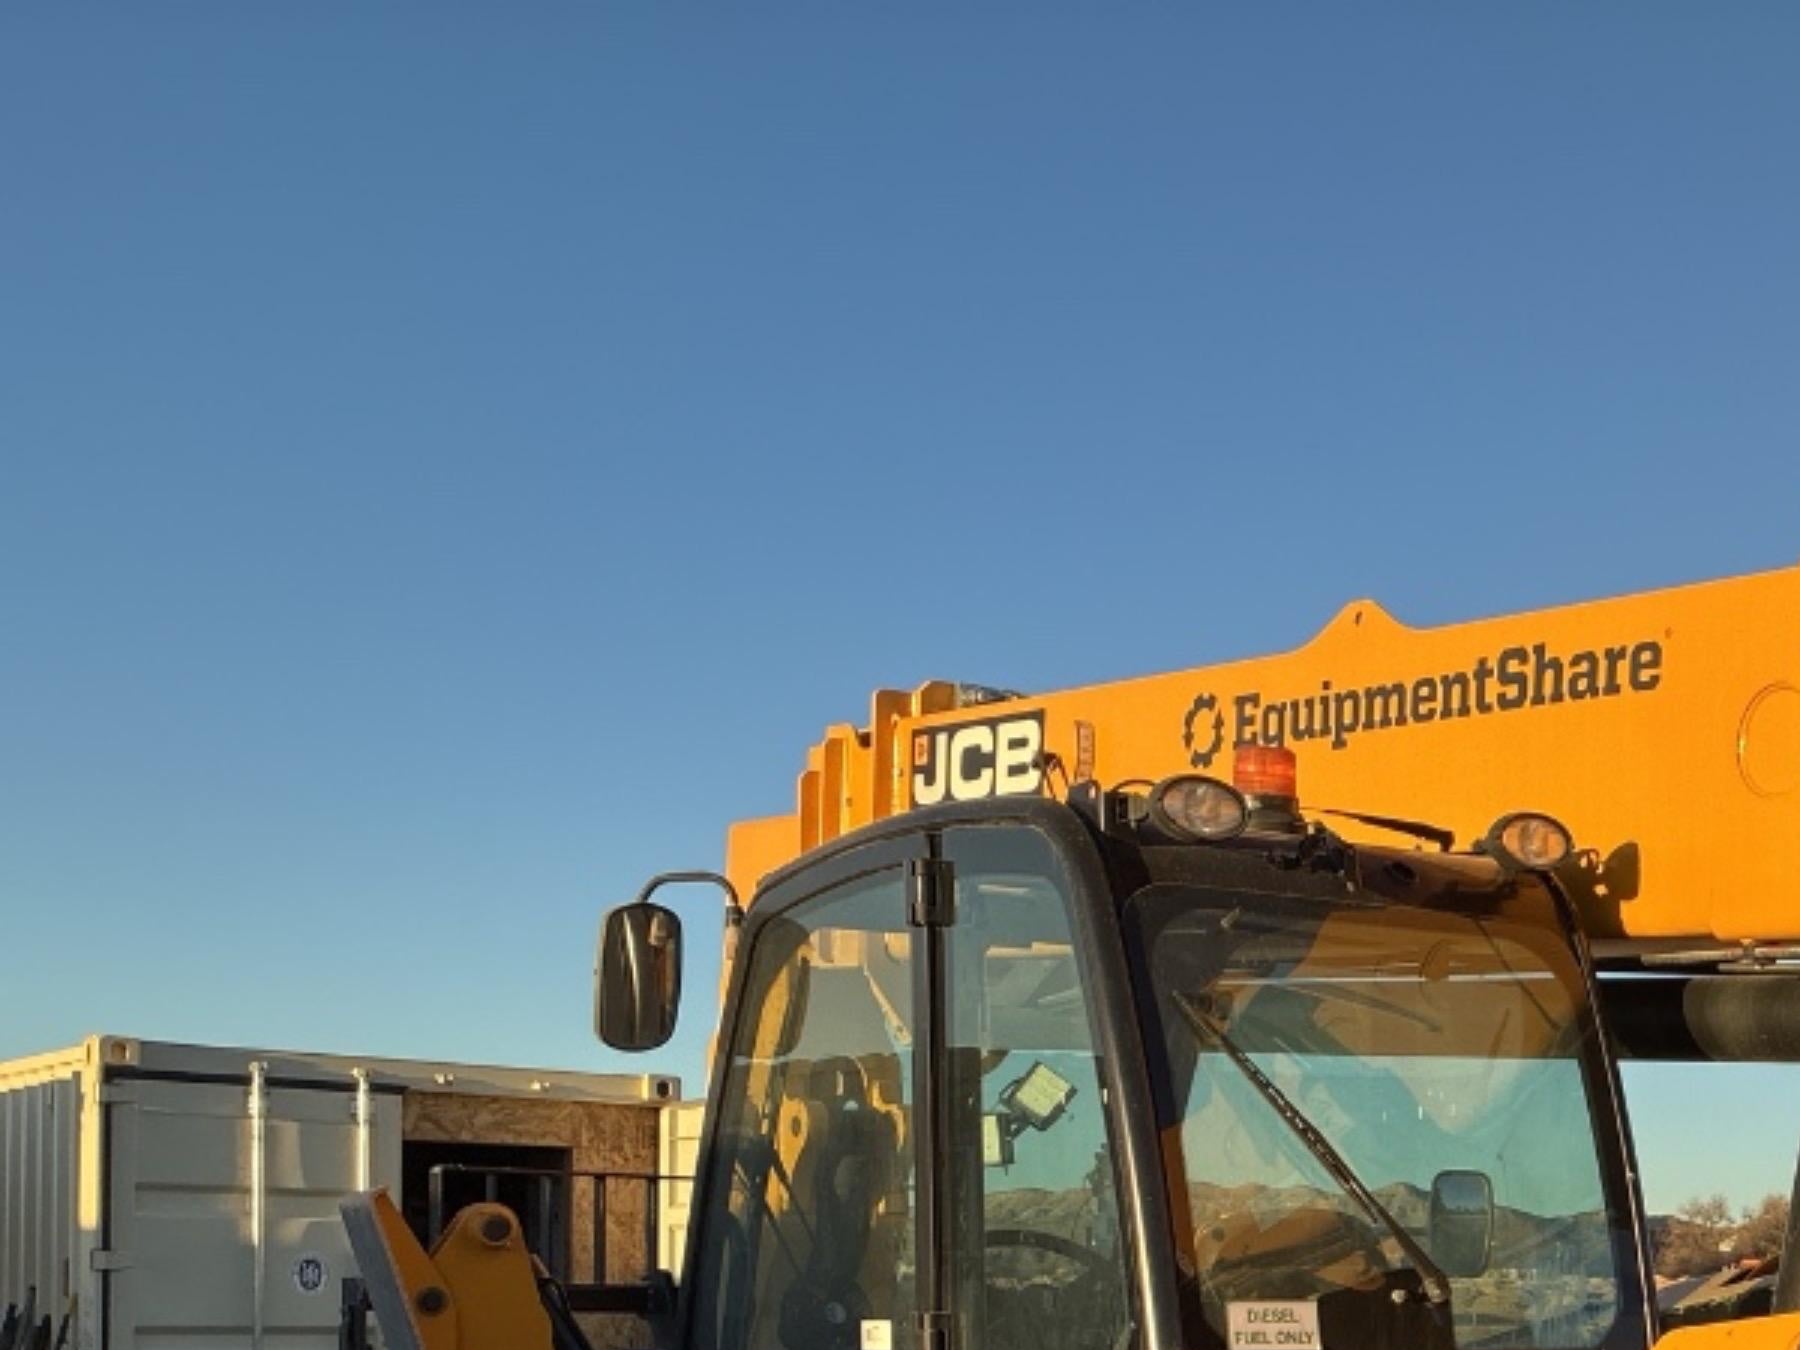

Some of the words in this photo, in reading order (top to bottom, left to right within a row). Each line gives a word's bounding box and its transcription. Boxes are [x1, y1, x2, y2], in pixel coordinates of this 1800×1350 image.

[1231, 640, 1663, 750] EquipmentShare
[914, 719, 1041, 804] JCB
[1235, 1331, 1273, 1345] FUEL
[1275, 1331, 1315, 1345] ONLY
[1247, 1307, 1300, 1324] DIESEL
